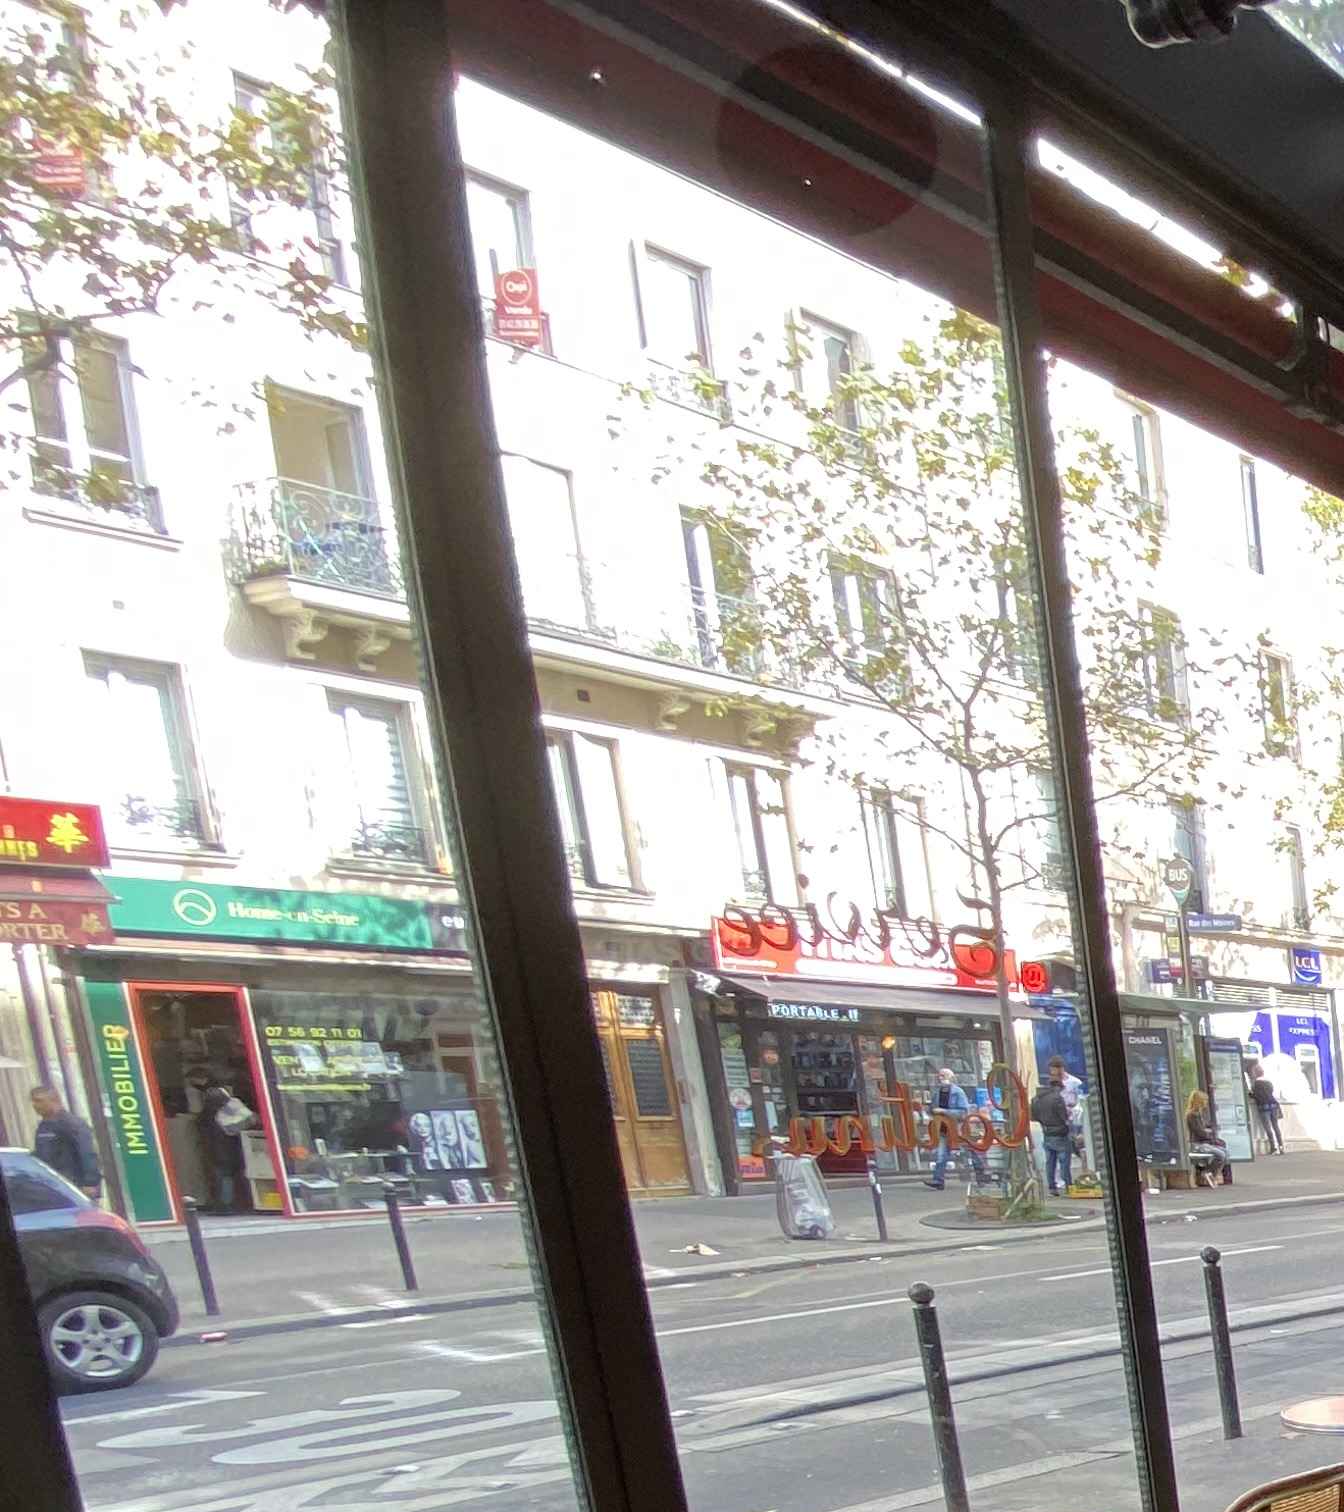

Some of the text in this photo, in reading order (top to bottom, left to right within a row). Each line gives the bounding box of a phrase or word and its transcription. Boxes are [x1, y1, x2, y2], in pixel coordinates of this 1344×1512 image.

[1168, 869, 1188, 882] BUS
[1295, 956, 1320, 971] LCL
[102, 1024, 149, 1154] IMMOBILIER
